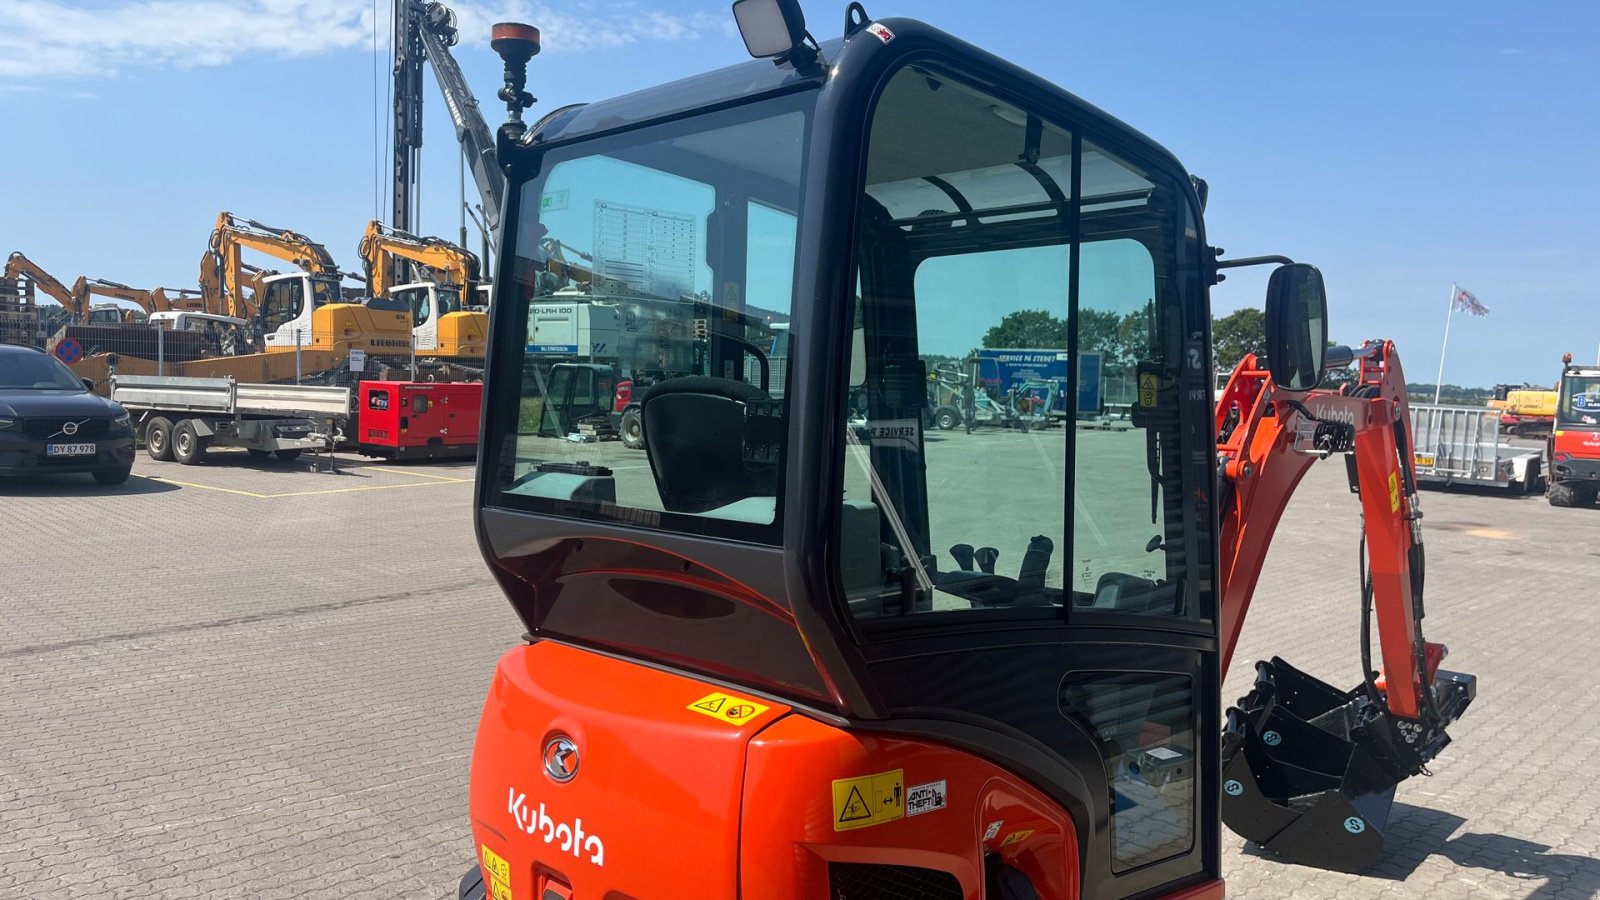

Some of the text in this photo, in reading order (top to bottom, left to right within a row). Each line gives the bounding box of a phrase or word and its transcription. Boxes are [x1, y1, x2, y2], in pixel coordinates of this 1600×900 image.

[1316, 403, 1354, 425] Kubota
[53, 444, 95, 454] DY 87 978
[908, 797, 932, 810] THEFT
[508, 786, 604, 867] Kubota
